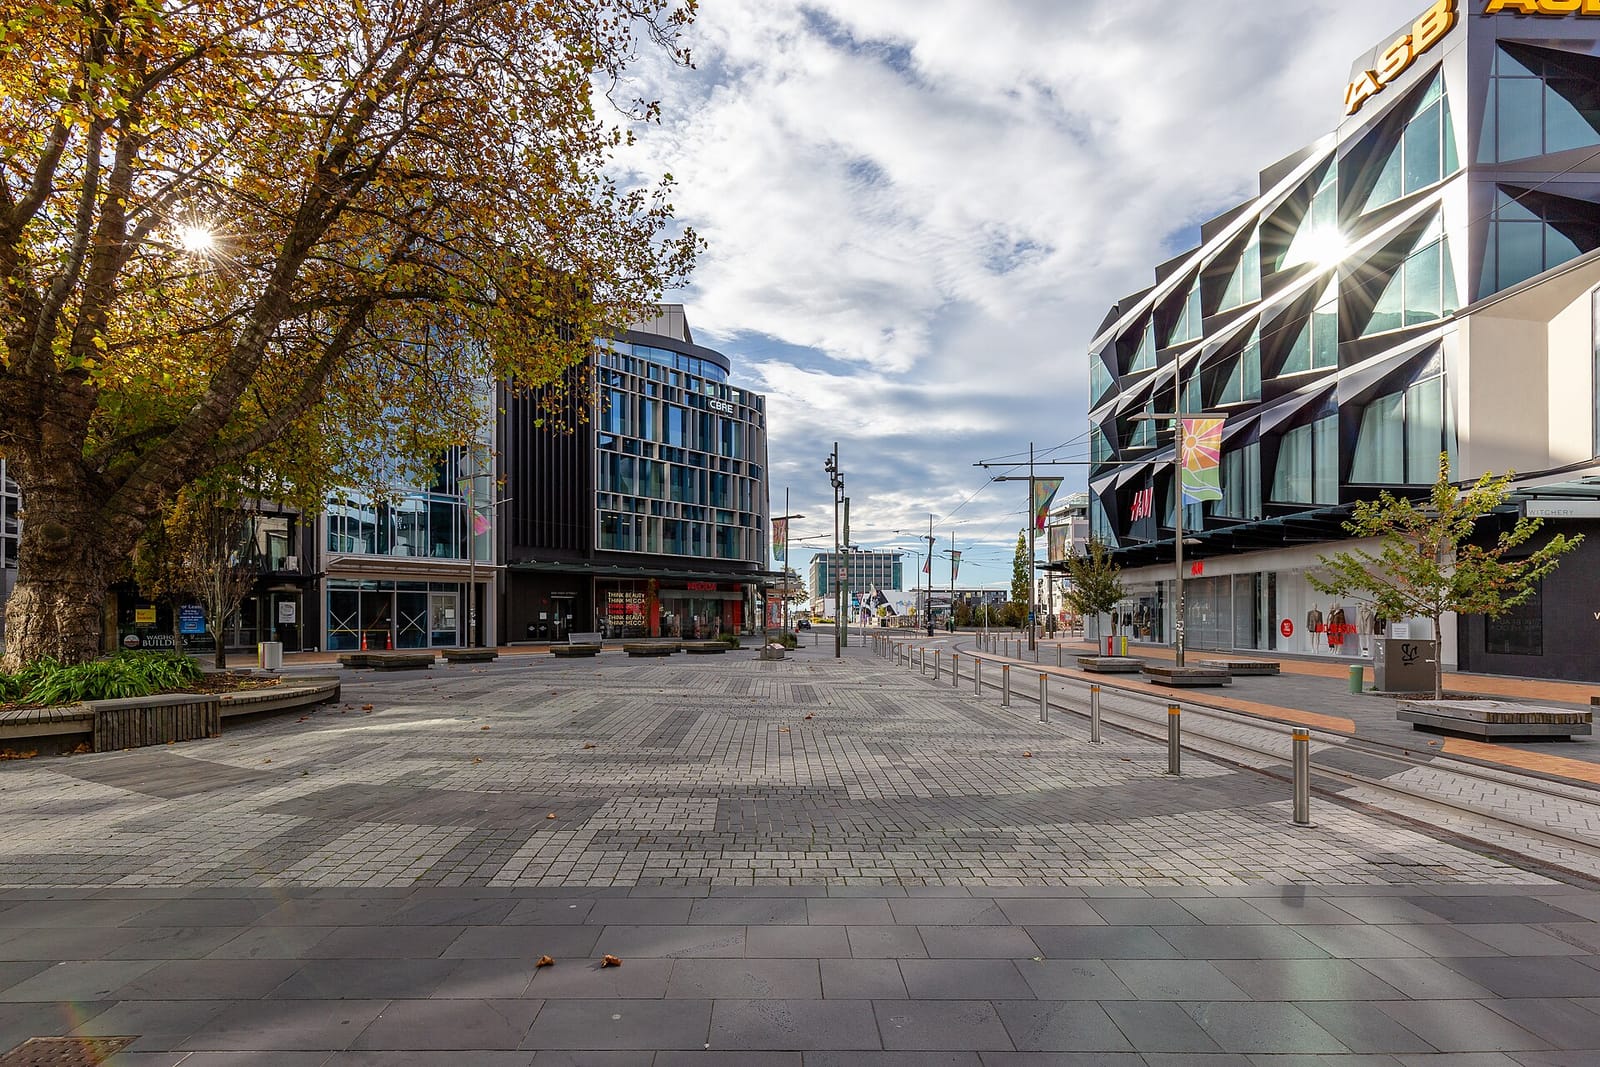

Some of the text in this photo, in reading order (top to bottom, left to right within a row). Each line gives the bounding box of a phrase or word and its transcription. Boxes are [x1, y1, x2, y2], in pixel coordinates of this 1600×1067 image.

[1344, 0, 1458, 115] ASB
[709, 400, 734, 414] CBRE
[1130, 486, 1154, 522] H&M
